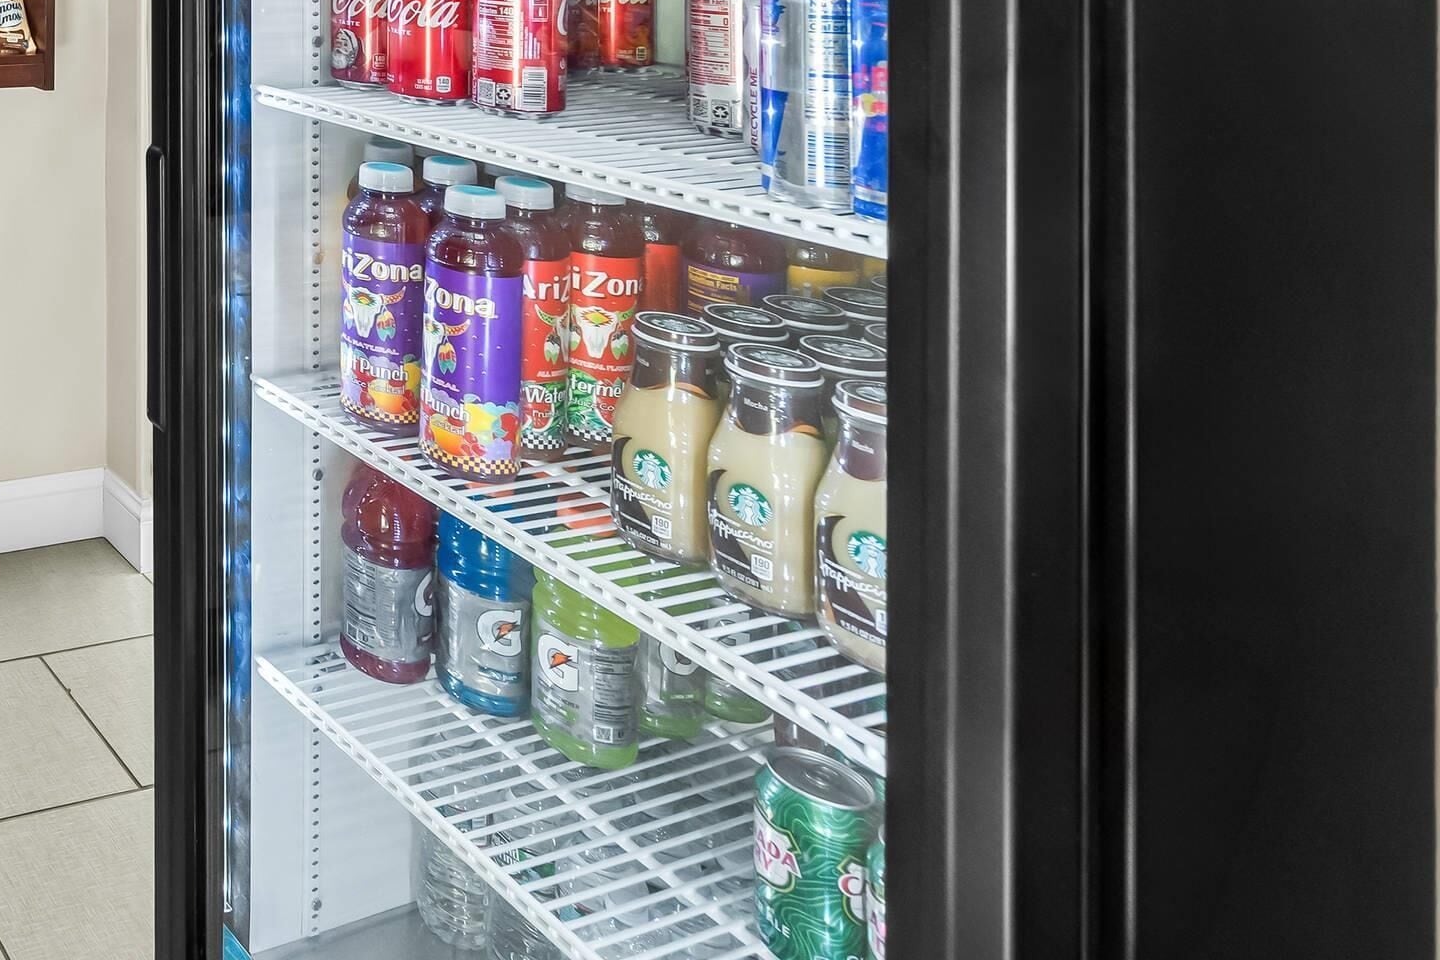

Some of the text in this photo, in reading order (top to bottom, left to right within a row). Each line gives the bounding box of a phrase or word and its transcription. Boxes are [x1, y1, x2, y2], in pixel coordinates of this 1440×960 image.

[750, 89, 758, 147] RECYCLE
[716, 279, 737, 291] Facts
[360, 357, 409, 382] Punch
[425, 388, 470, 422] Punch
[744, 397, 770, 412] Mocha
[655, 517, 670, 529] 190
[753, 556, 770, 570] 190
